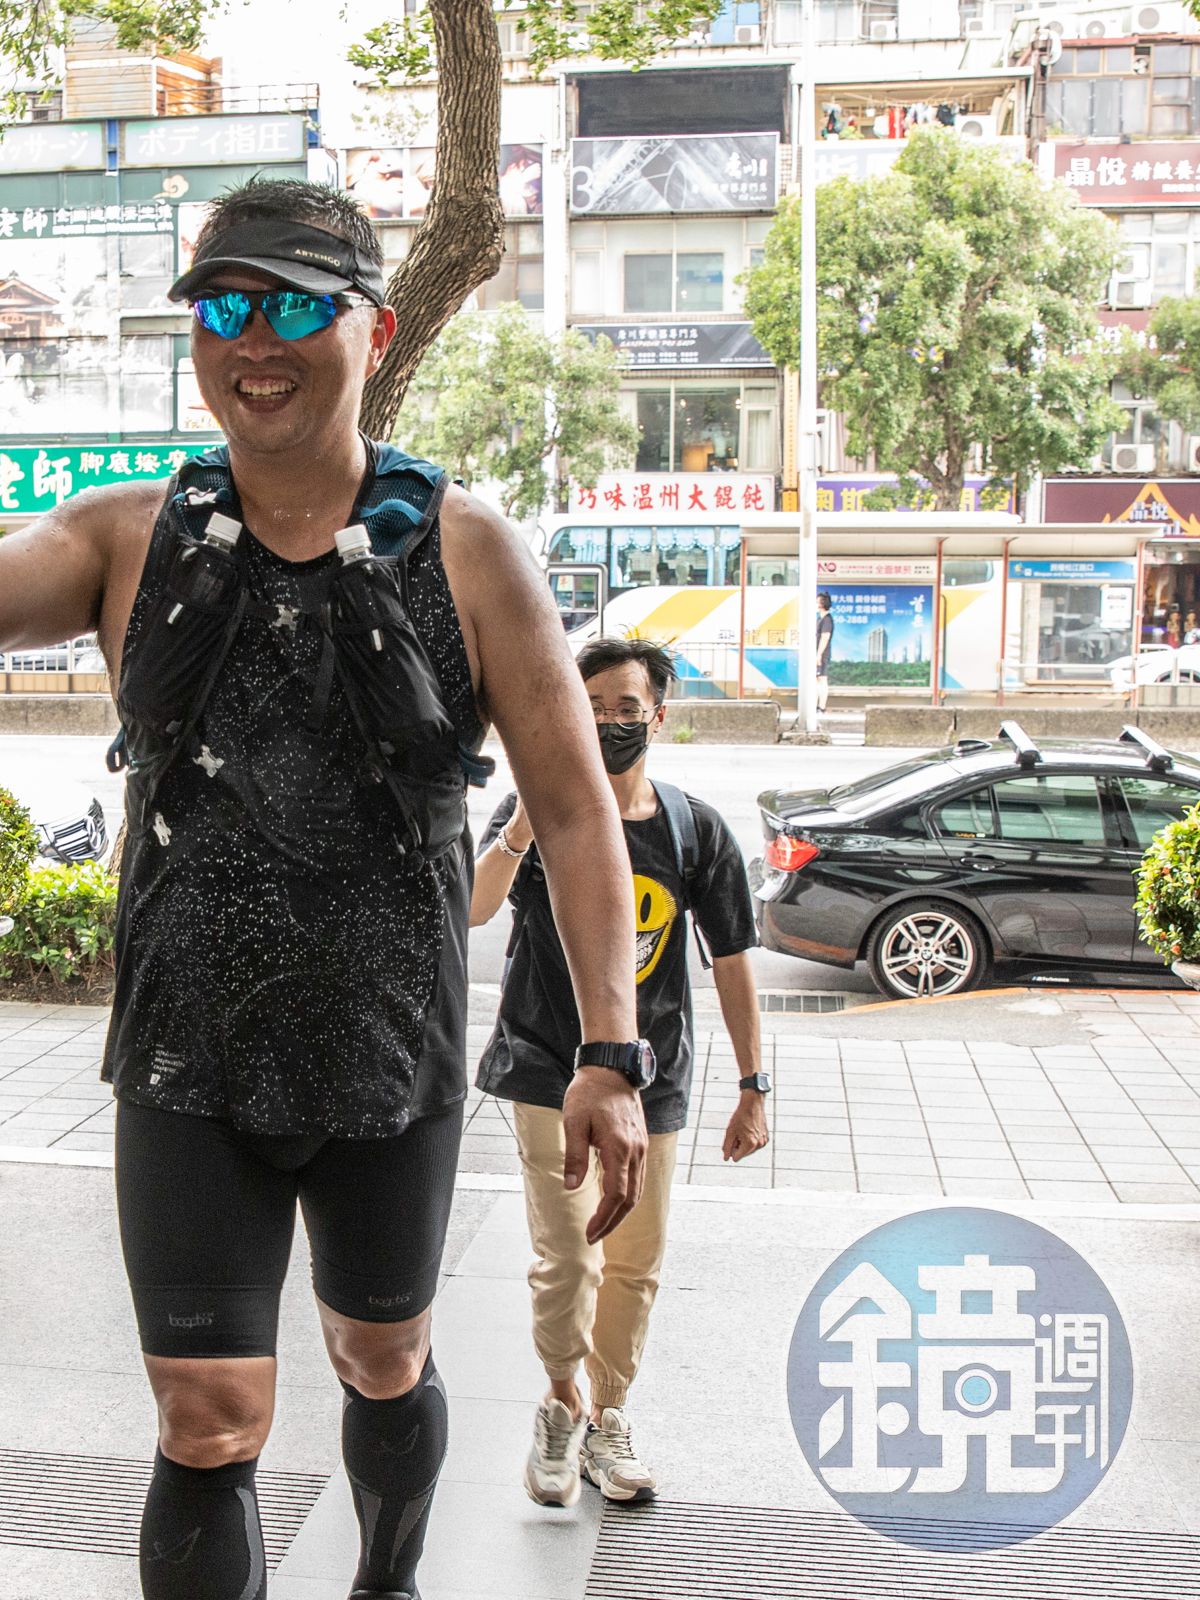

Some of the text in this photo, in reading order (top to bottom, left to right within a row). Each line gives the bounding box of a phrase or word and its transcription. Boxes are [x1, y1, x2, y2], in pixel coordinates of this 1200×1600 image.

[139, 122, 289, 156] ボディ指圧
[294, 249, 341, 267] ARTENGO
